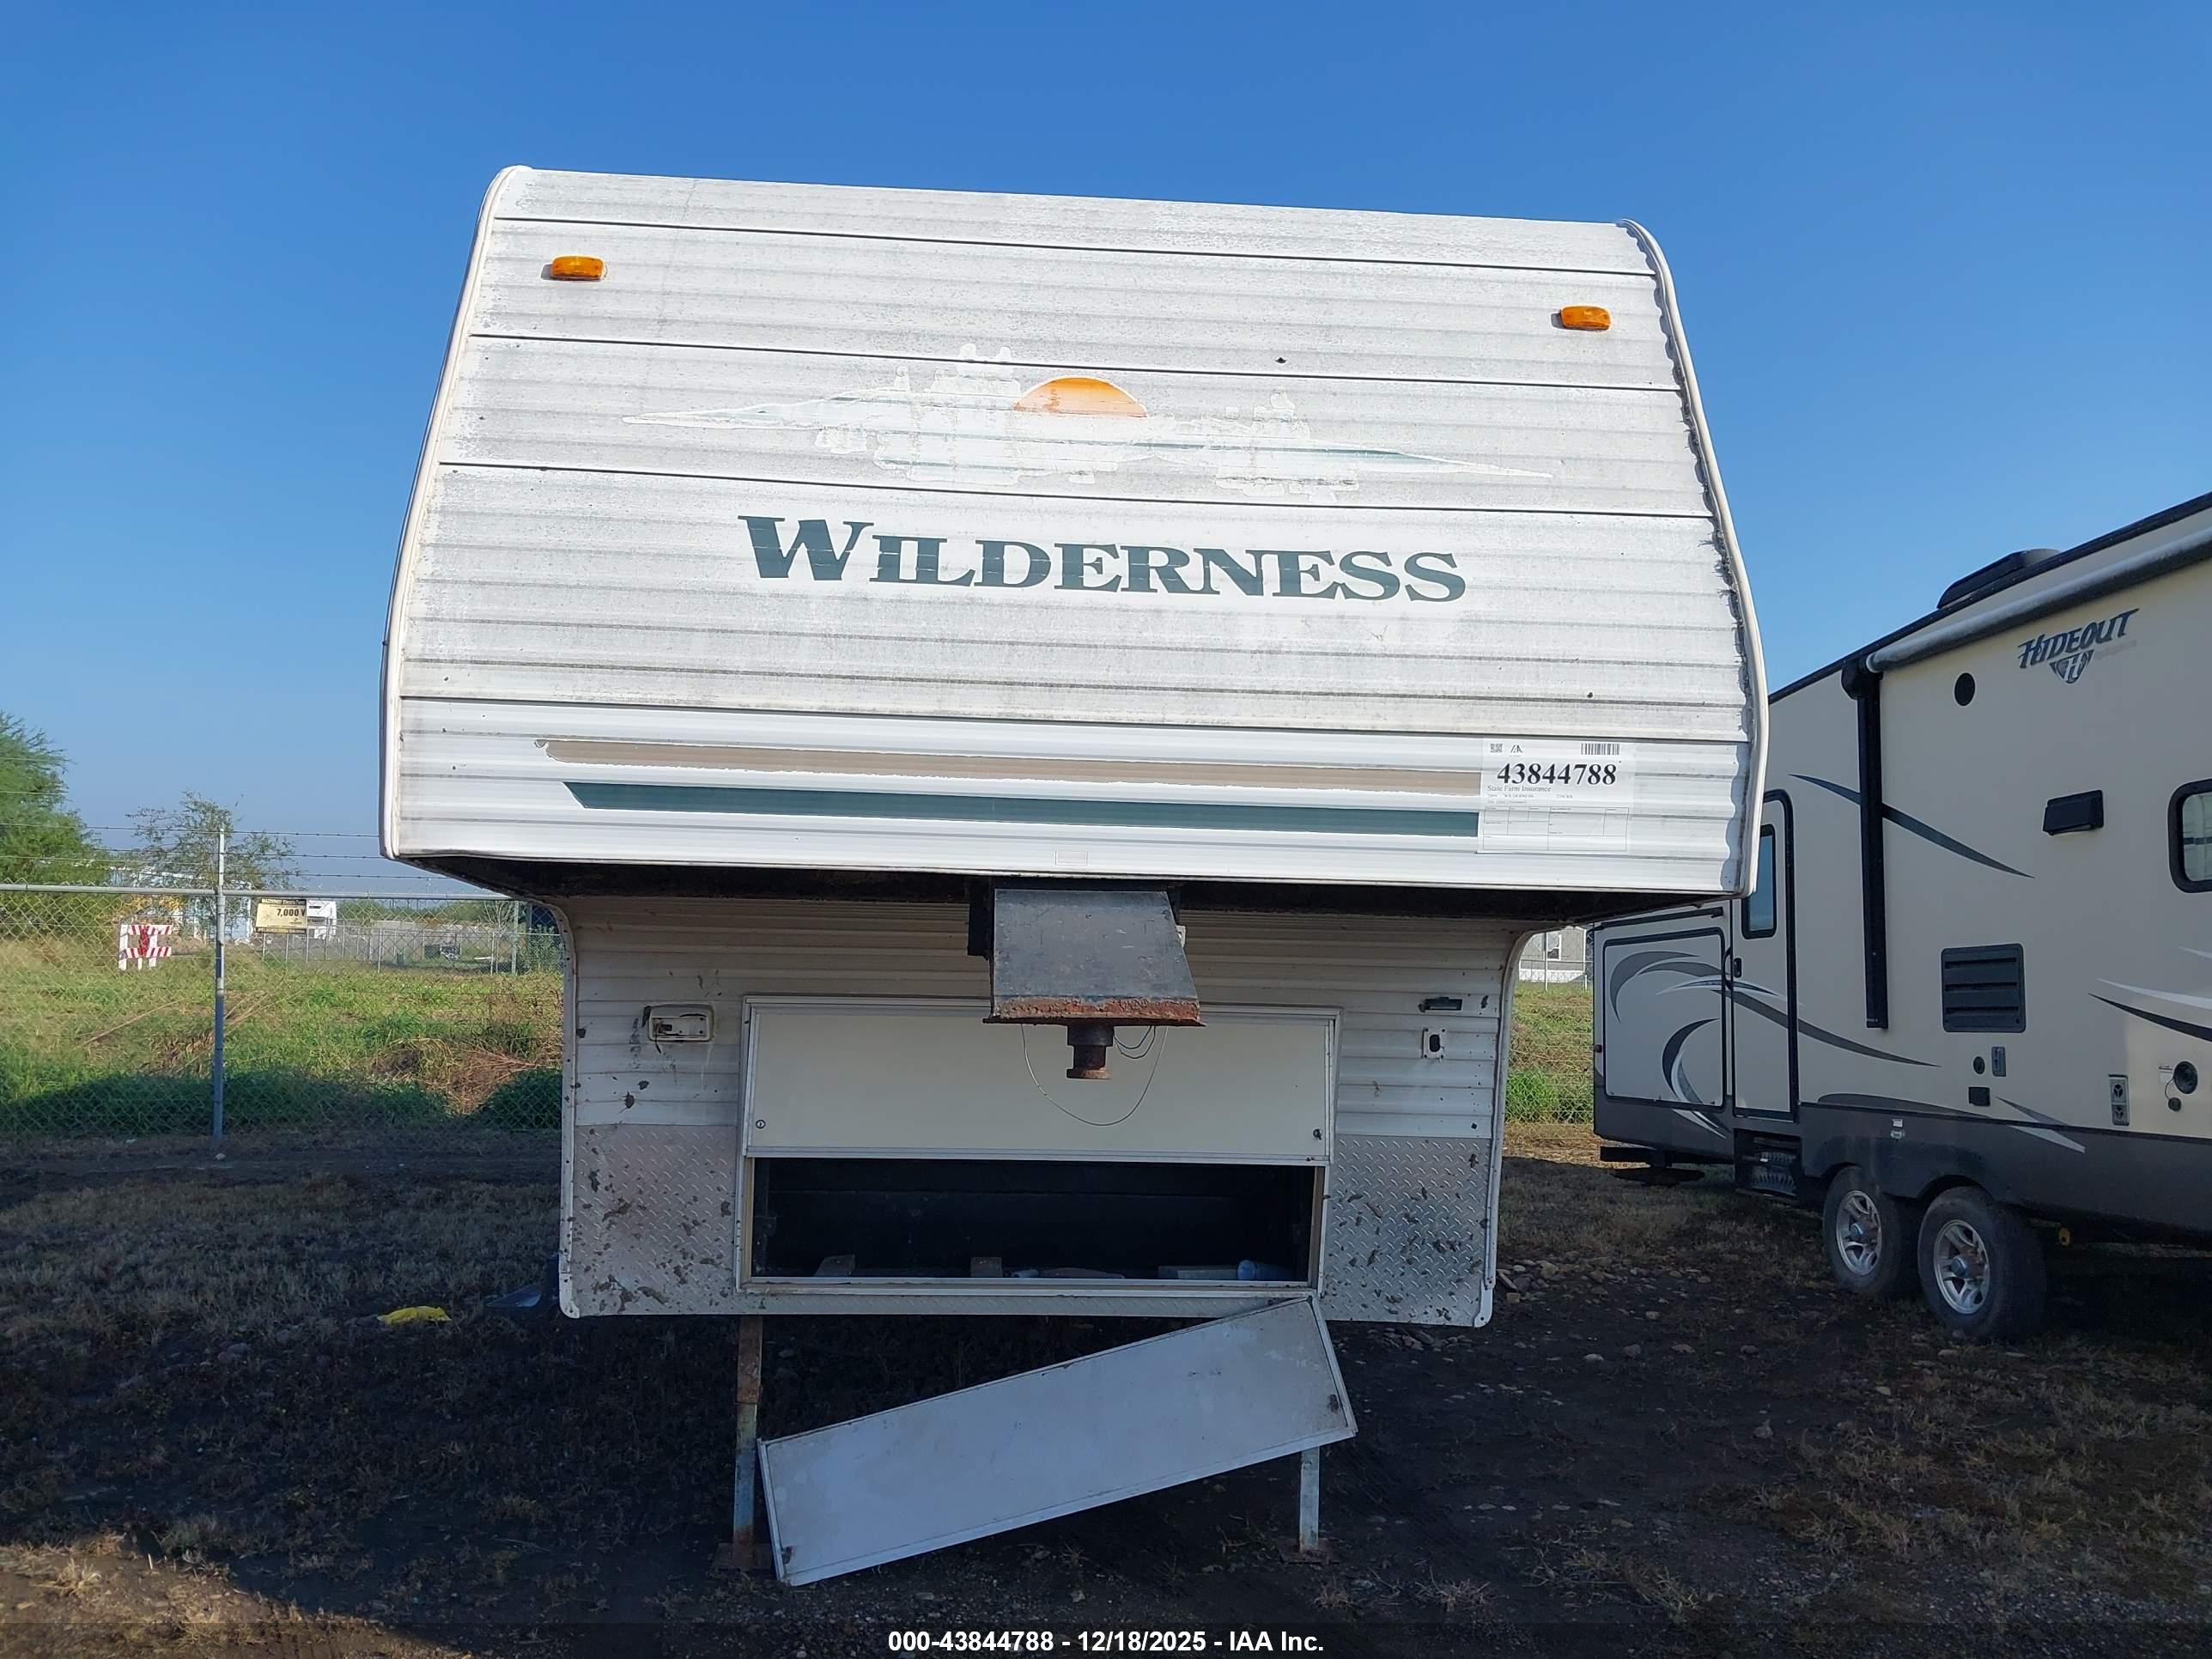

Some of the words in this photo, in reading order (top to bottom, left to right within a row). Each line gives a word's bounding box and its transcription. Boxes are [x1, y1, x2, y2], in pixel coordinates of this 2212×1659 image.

[738, 515, 1467, 602] WILDERNESS
[2017, 608, 2140, 669] HIDEOUT
[1497, 763, 1617, 785] 43844788
[276, 908, 299, 917] 7,000
